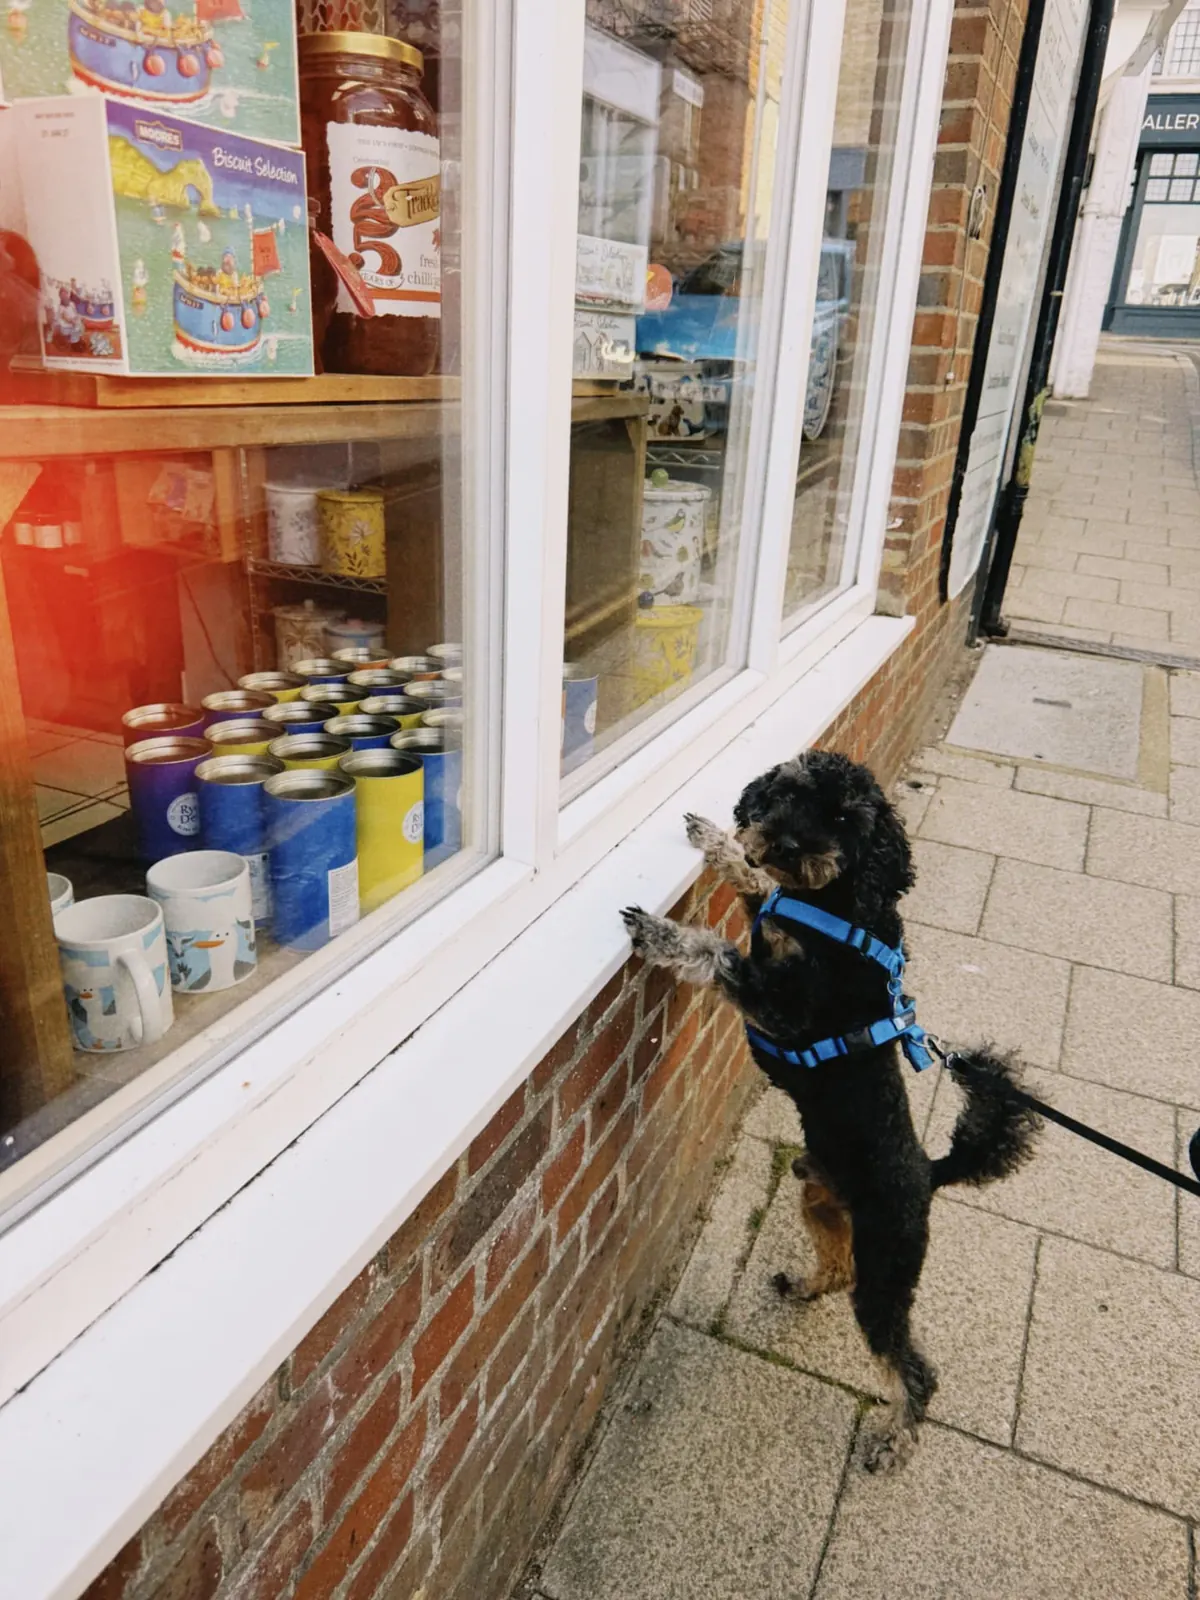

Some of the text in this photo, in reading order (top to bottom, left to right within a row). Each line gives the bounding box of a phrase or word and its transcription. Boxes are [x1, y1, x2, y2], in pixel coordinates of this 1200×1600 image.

[138, 124, 180, 146] MOORES
[212, 147, 299, 185] Biscuit Selection
